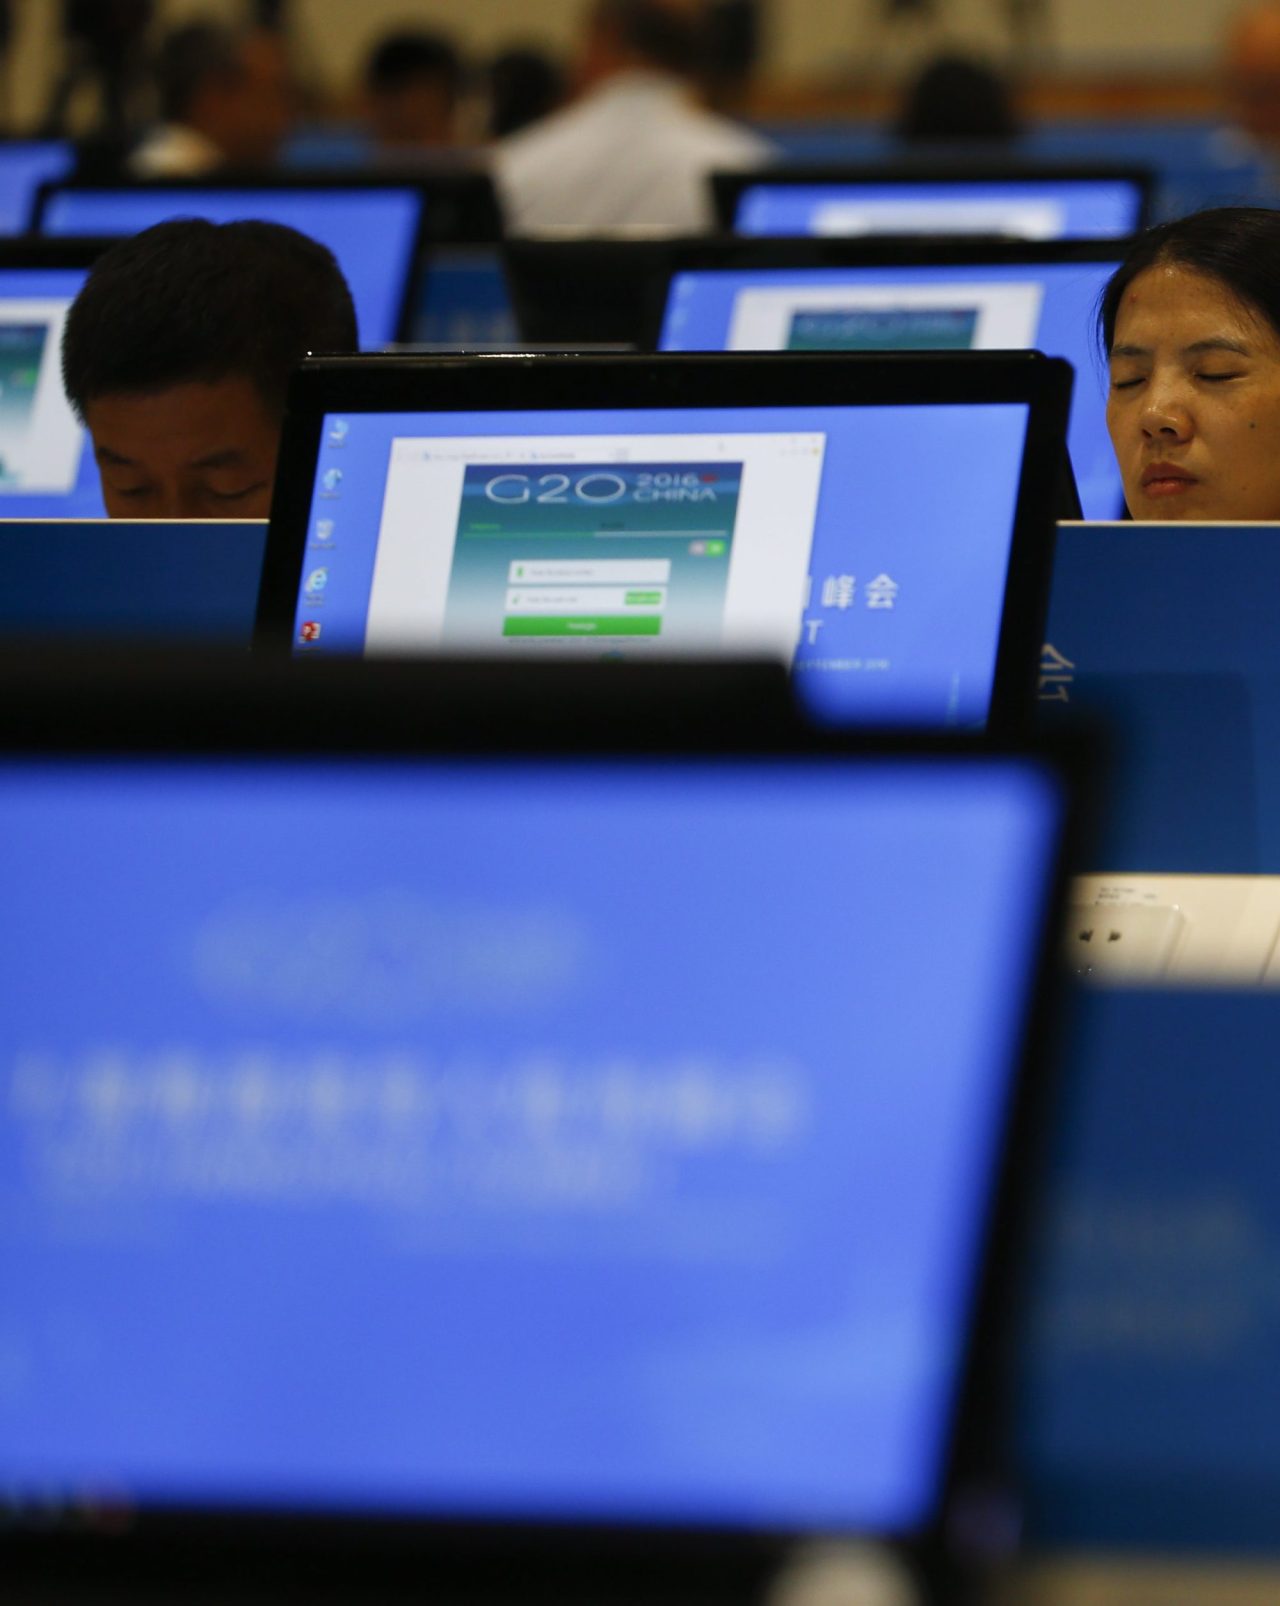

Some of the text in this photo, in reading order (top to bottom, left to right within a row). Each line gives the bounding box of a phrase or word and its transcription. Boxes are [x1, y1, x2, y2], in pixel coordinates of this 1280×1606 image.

[485, 472, 699, 504] G20 2016
[632, 487, 718, 503] CHINA
